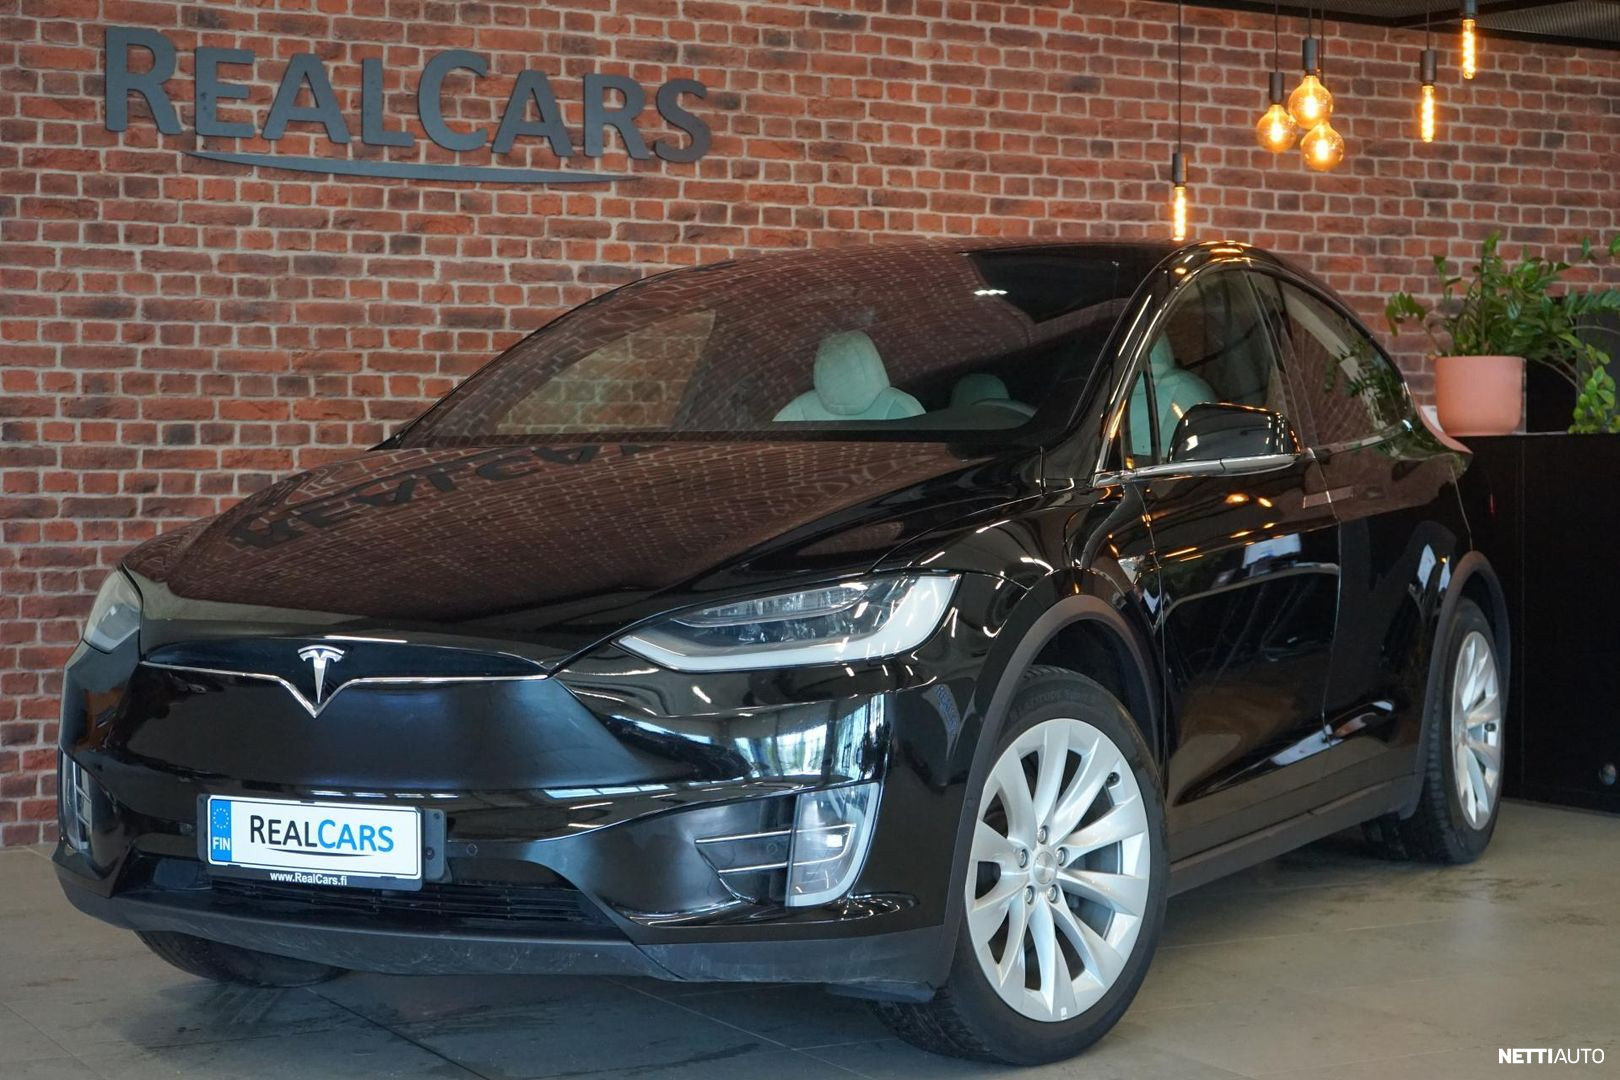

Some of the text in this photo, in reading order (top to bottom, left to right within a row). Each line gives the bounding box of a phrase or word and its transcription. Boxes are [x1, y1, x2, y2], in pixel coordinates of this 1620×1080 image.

[105, 27, 712, 163] REALCARS
[212, 837, 231, 851] FIN
[249, 815, 394, 852] REALCARS
[270, 872, 348, 887] www.RealCars.fi
